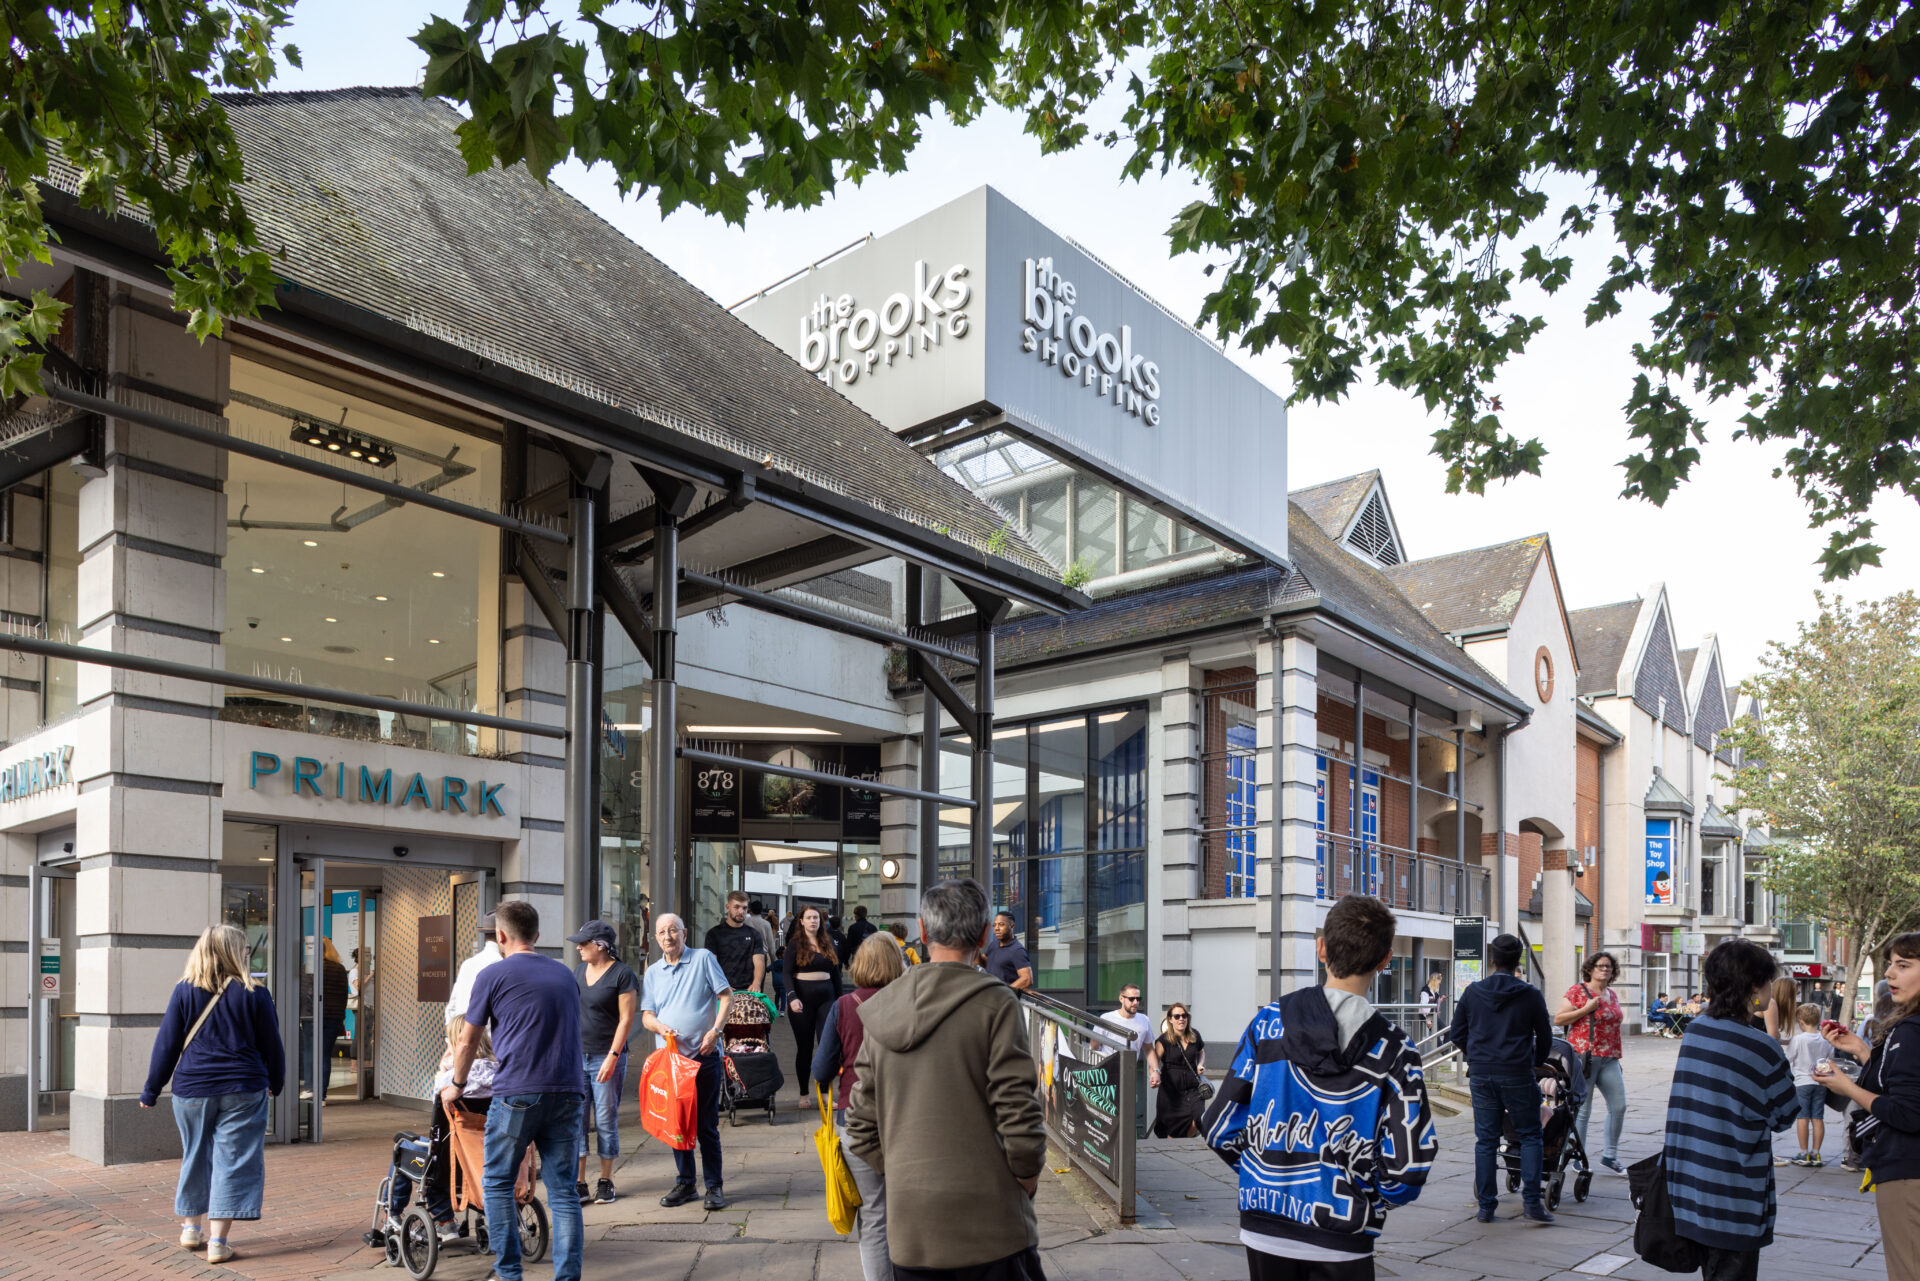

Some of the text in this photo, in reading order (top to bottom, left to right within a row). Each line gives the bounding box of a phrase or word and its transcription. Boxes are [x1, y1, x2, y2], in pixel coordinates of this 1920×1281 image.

[1036, 257, 1077, 305] the
[800, 259, 970, 373] brooks
[812, 293, 855, 331] the
[1025, 258, 1161, 401] brooks
[817, 311, 969, 389] HOPPING
[1023, 326, 1160, 427] SHOPPING
[0, 745, 75, 804] RIMARK
[250, 751, 506, 817] PRIMARK
[697, 769, 735, 791] 878
[1646, 860, 1666, 869] Shop
[1648, 841, 1663, 849] The
[1650, 851, 1662, 860] Toy
[1256, 1018, 1285, 1040] IG
[1246, 1099, 1319, 1155] World
[1324, 1114, 1377, 1162] Cup
[1239, 1187, 1313, 1225] FIGHTING
